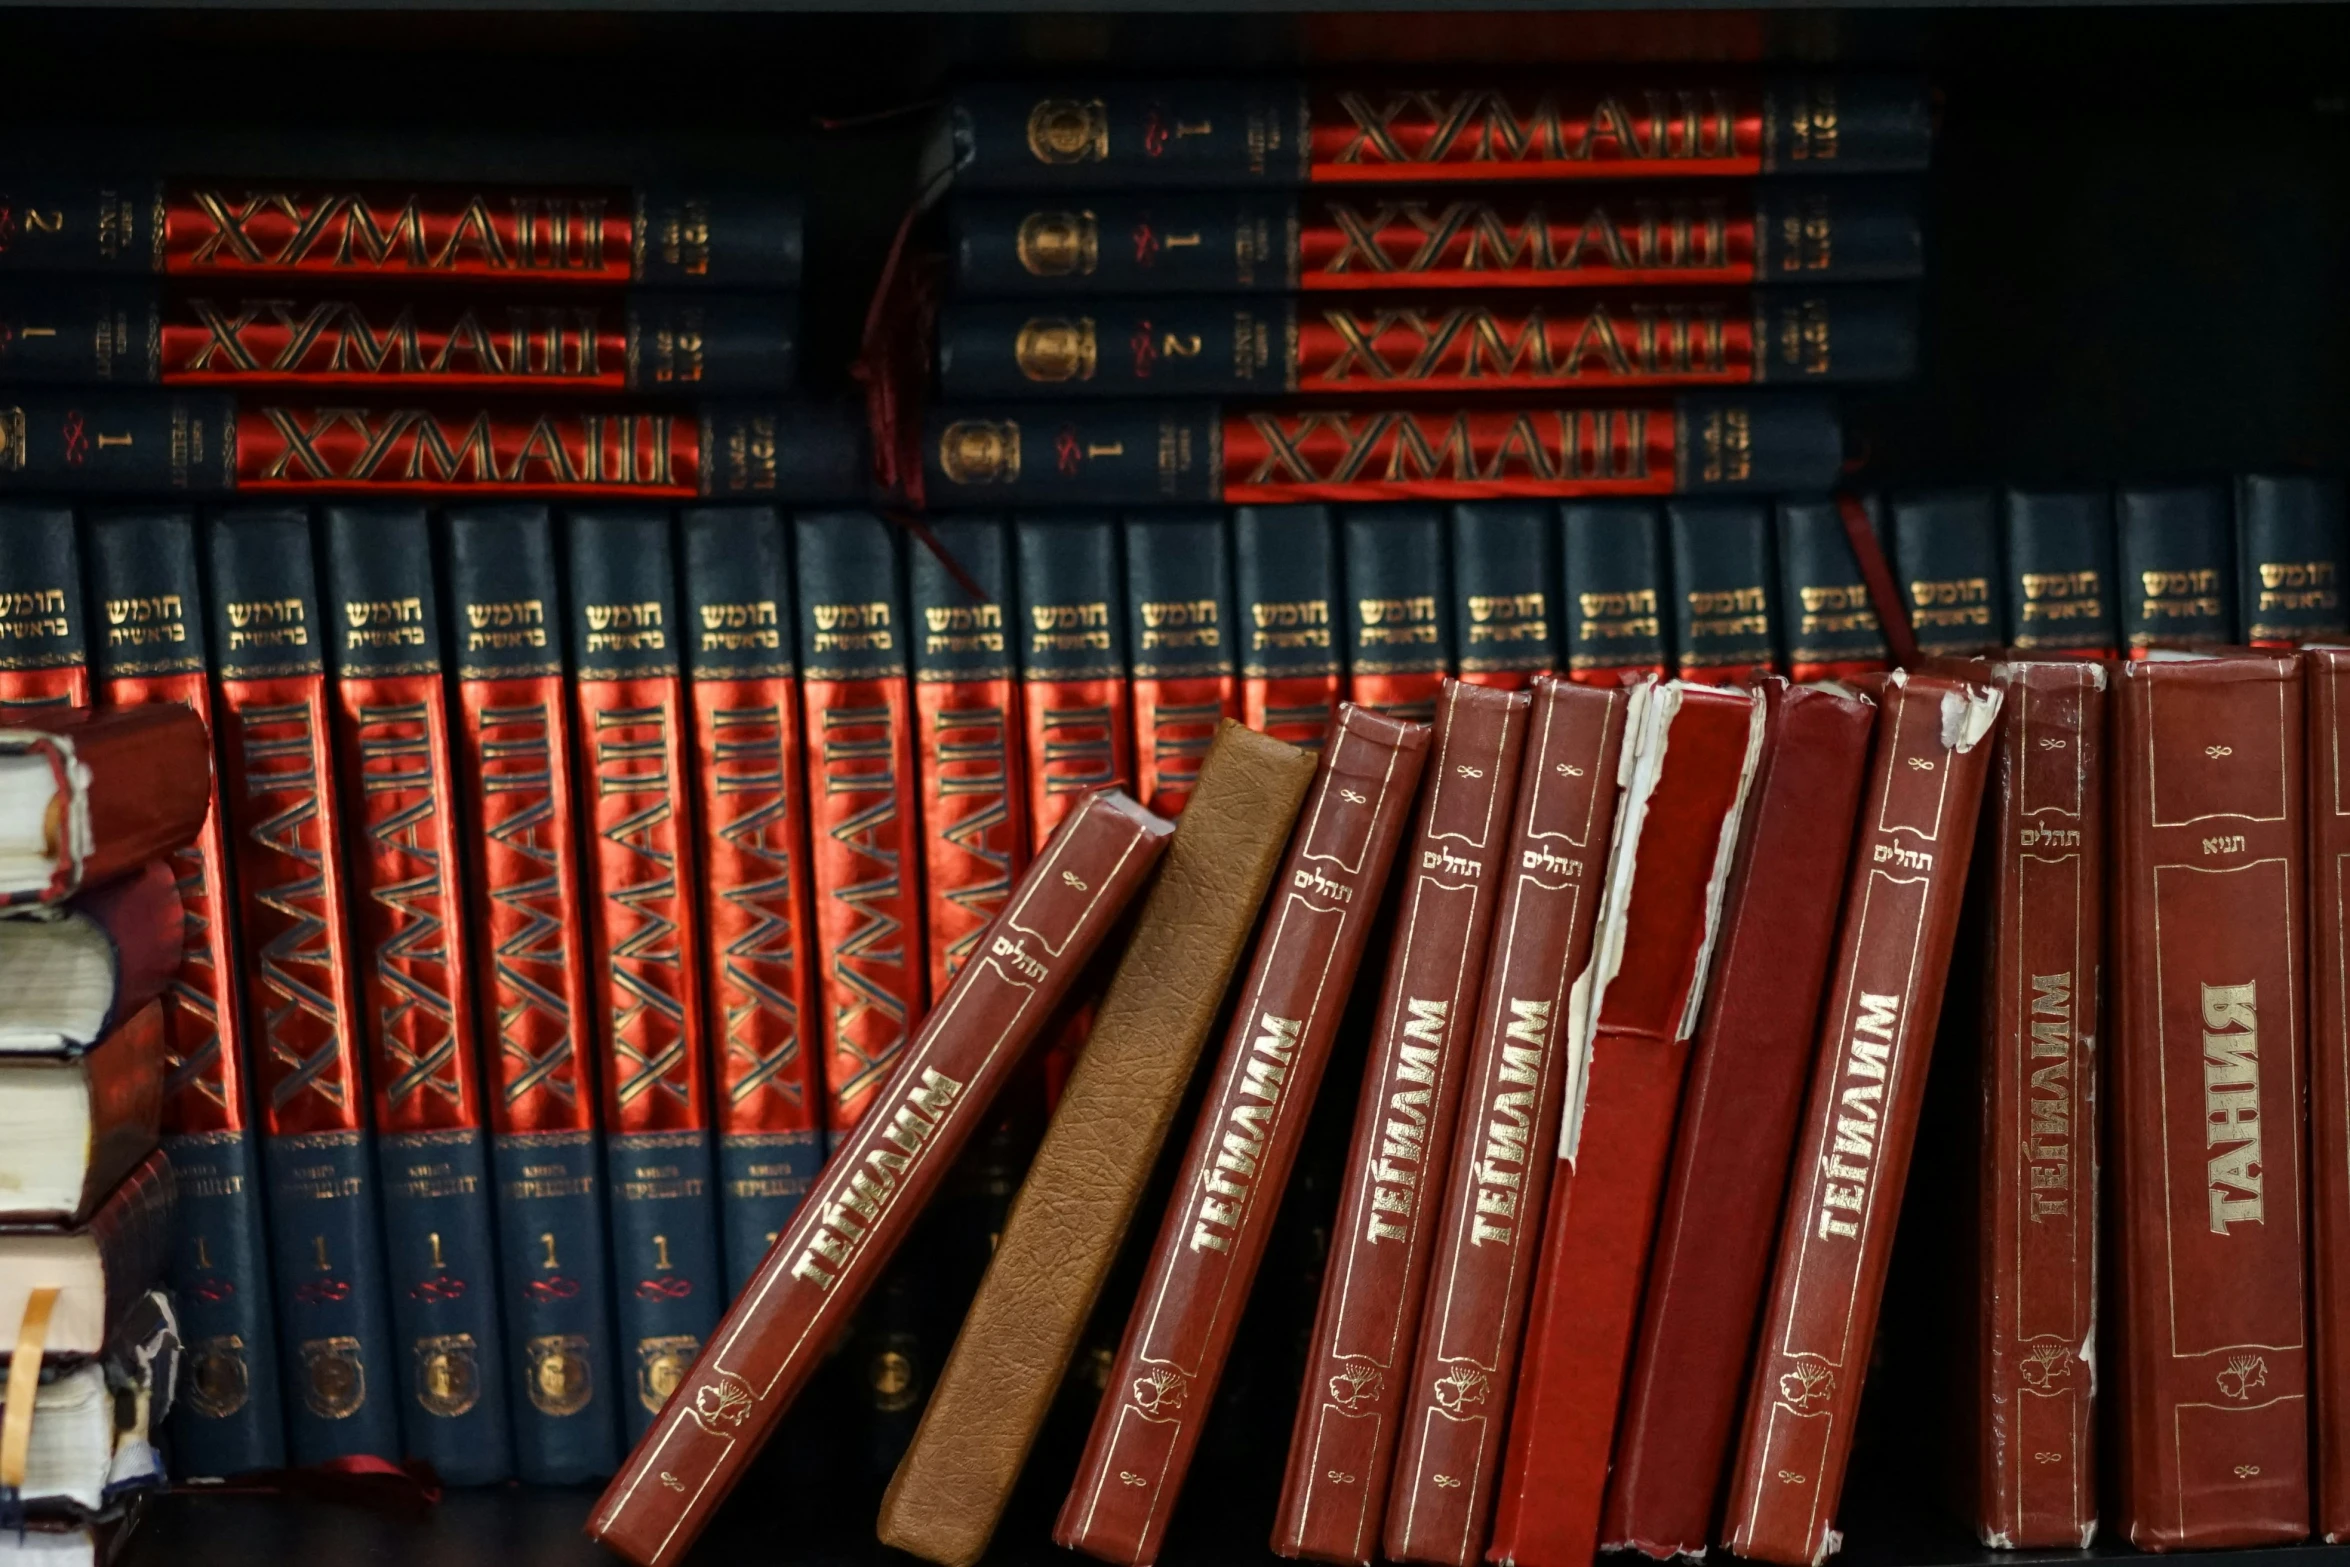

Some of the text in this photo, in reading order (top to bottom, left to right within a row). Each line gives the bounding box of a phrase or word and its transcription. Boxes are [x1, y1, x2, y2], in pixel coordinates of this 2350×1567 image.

[24, 207, 63, 233] 2
[1165, 227, 1202, 249] 1
[1162, 334, 1201, 360] 2
[97, 431, 133, 450] 1
[262, 406, 674, 484] ХУМАШ
[1089, 438, 1124, 459] 1
[1246, 411, 1653, 485] ХУМАШ
[2021, 571, 2099, 600] חומש
[2142, 568, 2219, 598] חומש
[2259, 562, 2336, 589] חומש
[0, 588, 66, 616] חומש
[1580, 588, 1658, 618] חומש
[1688, 586, 1765, 615] חומש
[1911, 577, 1989, 606] חומש
[105, 593, 182, 624] חומש
[226, 597, 304, 627] חומש
[345, 596, 423, 627] חומש
[467, 598, 544, 629] חומש
[585, 600, 662, 630] חומש
[700, 599, 777, 630] חומש
[812, 601, 890, 630] חומש
[925, 604, 1002, 632] חומש
[1031, 602, 1108, 630] חומש
[1140, 600, 1218, 628] חומש
[1252, 600, 1329, 628] חומש
[1359, 596, 1436, 625] חומש
[1468, 593, 1546, 622] חומש
[2020, 820, 2080, 848] תהלים
[2202, 834, 2246, 856] תניא
[1423, 847, 1482, 879] תהלים
[1523, 845, 1582, 877] תהלים
[1873, 841, 1933, 873] תהלים
[1294, 867, 1353, 903] תהלים
[358, 700, 461, 1110] ХУМАШ
[479, 702, 576, 1106] ХУМАШ
[595, 701, 689, 1106] ХУМАШ
[711, 703, 803, 1106] ХУМАШ
[992, 935, 1049, 984] תהלים
[2202, 979, 2264, 1236] ТАНИЯ
[196, 1236, 212, 1270] 1
[313, 1236, 331, 1271] 1
[428, 1231, 446, 1268] 1
[540, 1232, 560, 1269] 1
[652, 1234, 673, 1269] 1
